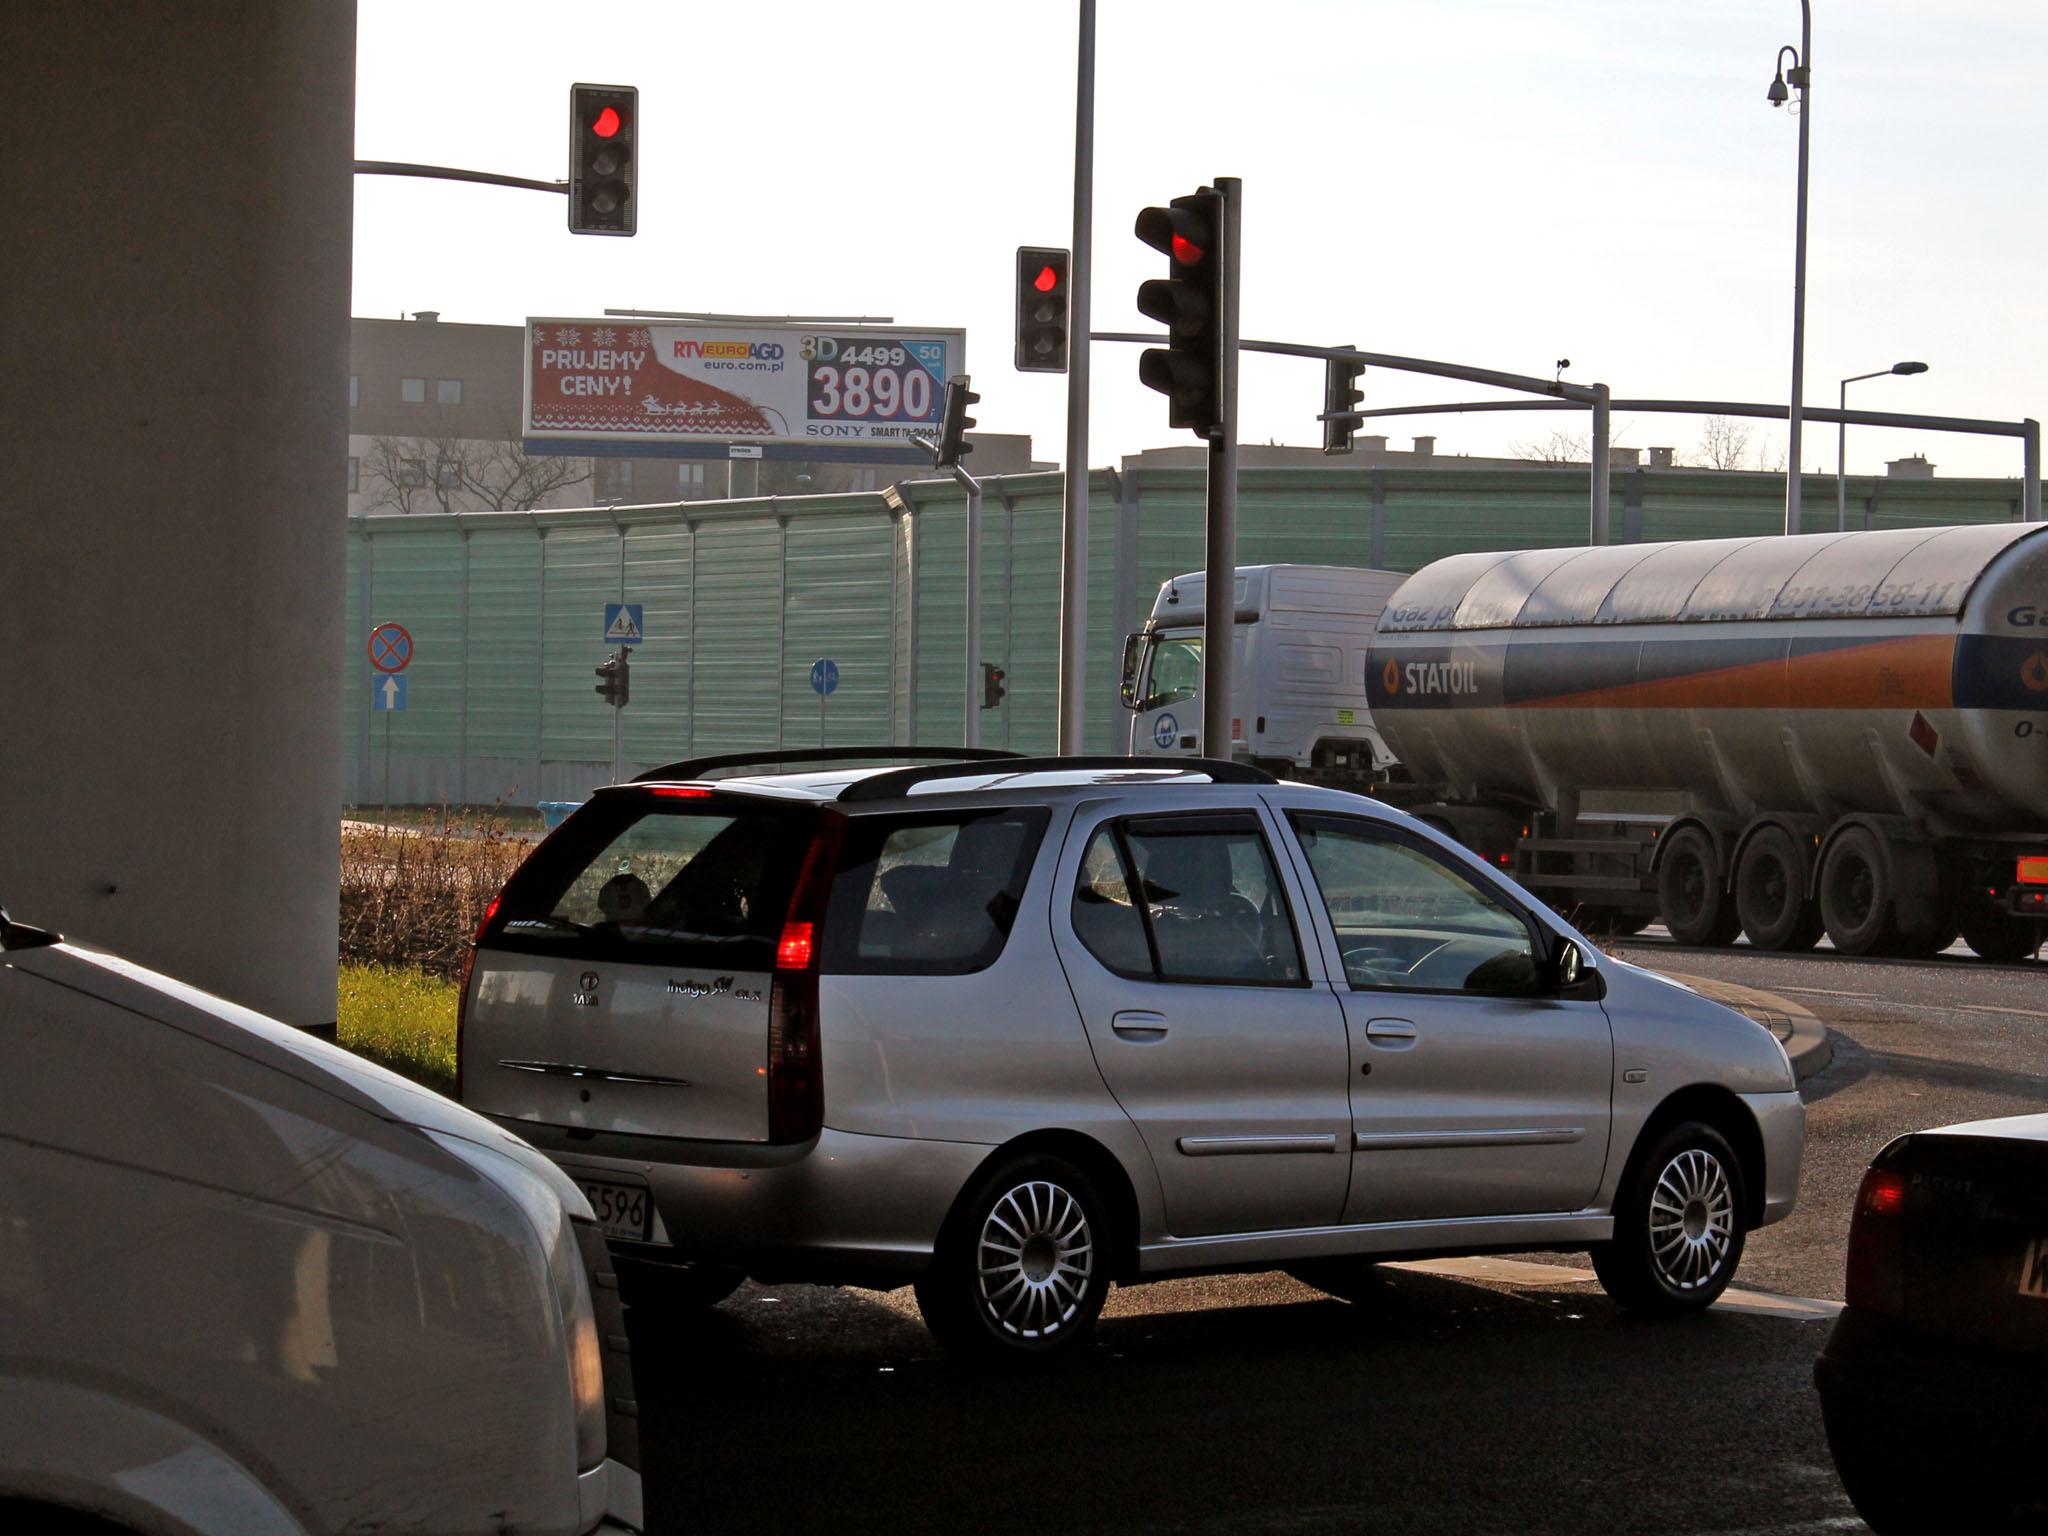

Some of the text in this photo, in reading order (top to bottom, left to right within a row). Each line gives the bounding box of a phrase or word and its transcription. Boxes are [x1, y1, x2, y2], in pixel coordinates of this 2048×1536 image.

[542, 349, 646, 371] PRUJEMY
[799, 334, 942, 366] 3D 4499 50
[704, 361, 785, 373] euro.com.pl
[813, 365, 931, 417] 3890
[806, 424, 865, 437] SONY
[870, 426, 902, 438] SMART
[1391, 602, 1429, 623] Gaz
[1405, 661, 1478, 695] STATOIL
[2014, 719, 2048, 738] 0-
